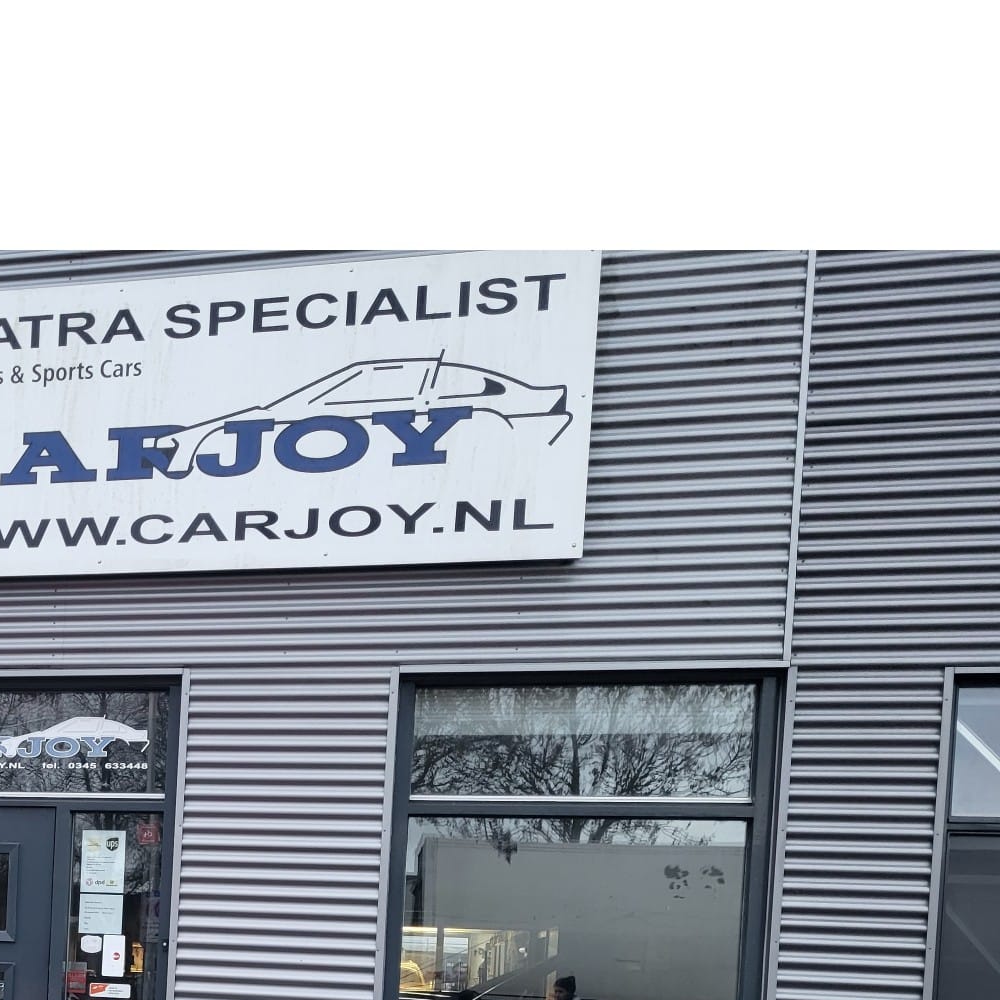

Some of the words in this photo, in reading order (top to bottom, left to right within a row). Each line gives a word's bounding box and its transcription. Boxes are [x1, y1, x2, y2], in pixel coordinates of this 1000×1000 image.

[163, 273, 567, 339] SPECIALIST
[10, 365, 25, 384] &
[31, 362, 94, 388] Sports
[100, 359, 143, 379] Cars
[41, 761, 60, 770] tel.
[67, 761, 98, 770] 0345
[104, 761, 149, 771] 633448
